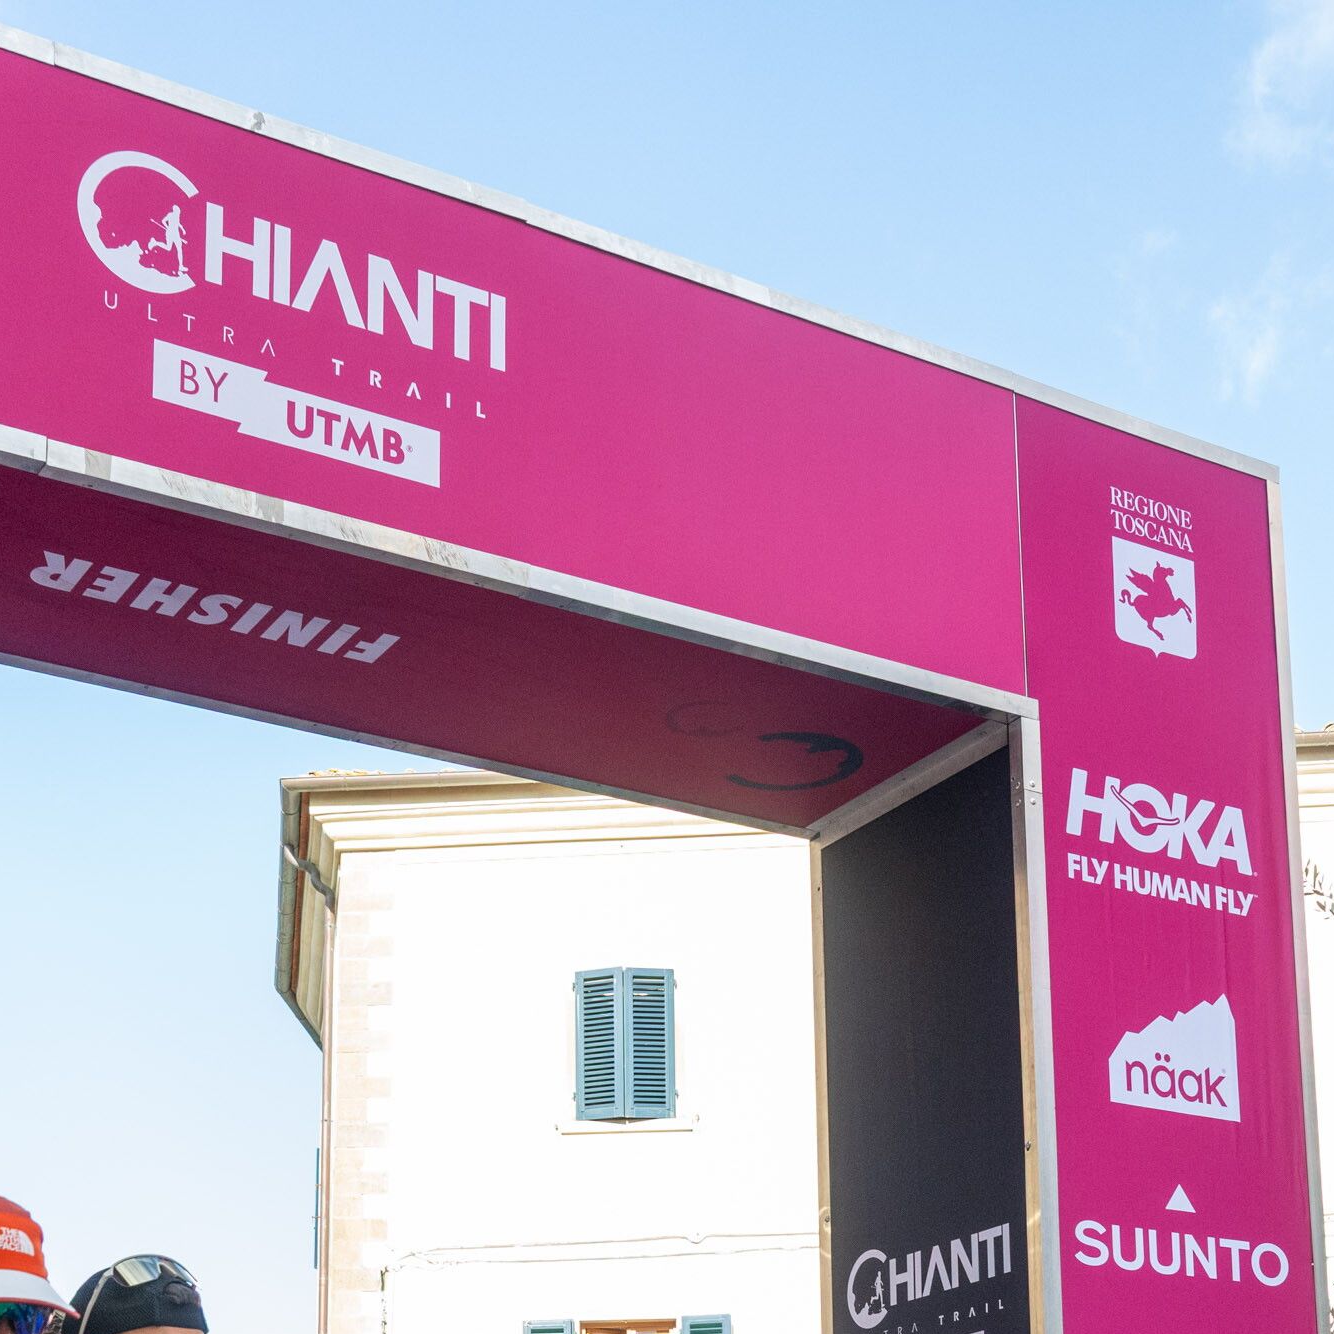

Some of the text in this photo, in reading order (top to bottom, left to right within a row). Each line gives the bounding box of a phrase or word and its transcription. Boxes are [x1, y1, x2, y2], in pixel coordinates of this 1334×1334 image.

[77, 150, 507, 373] CHIANTI
[102, 288, 487, 420] ULTRA TRAIL
[178, 359, 408, 466] BY UTMB
[1109, 486, 1193, 530] REGIONE
[1110, 509, 1194, 553] TOSCANA
[29, 550, 401, 664] FINISHER
[1066, 767, 1253, 876] HOKA
[1067, 852, 1255, 917] FLY HUMAN FLY
[1125, 1052, 1227, 1107] näak
[847, 1223, 1011, 1329] CHIANTI
[1074, 1220, 1289, 1287] SUUNTO
[938, 1300, 1004, 1326] TRAIL
